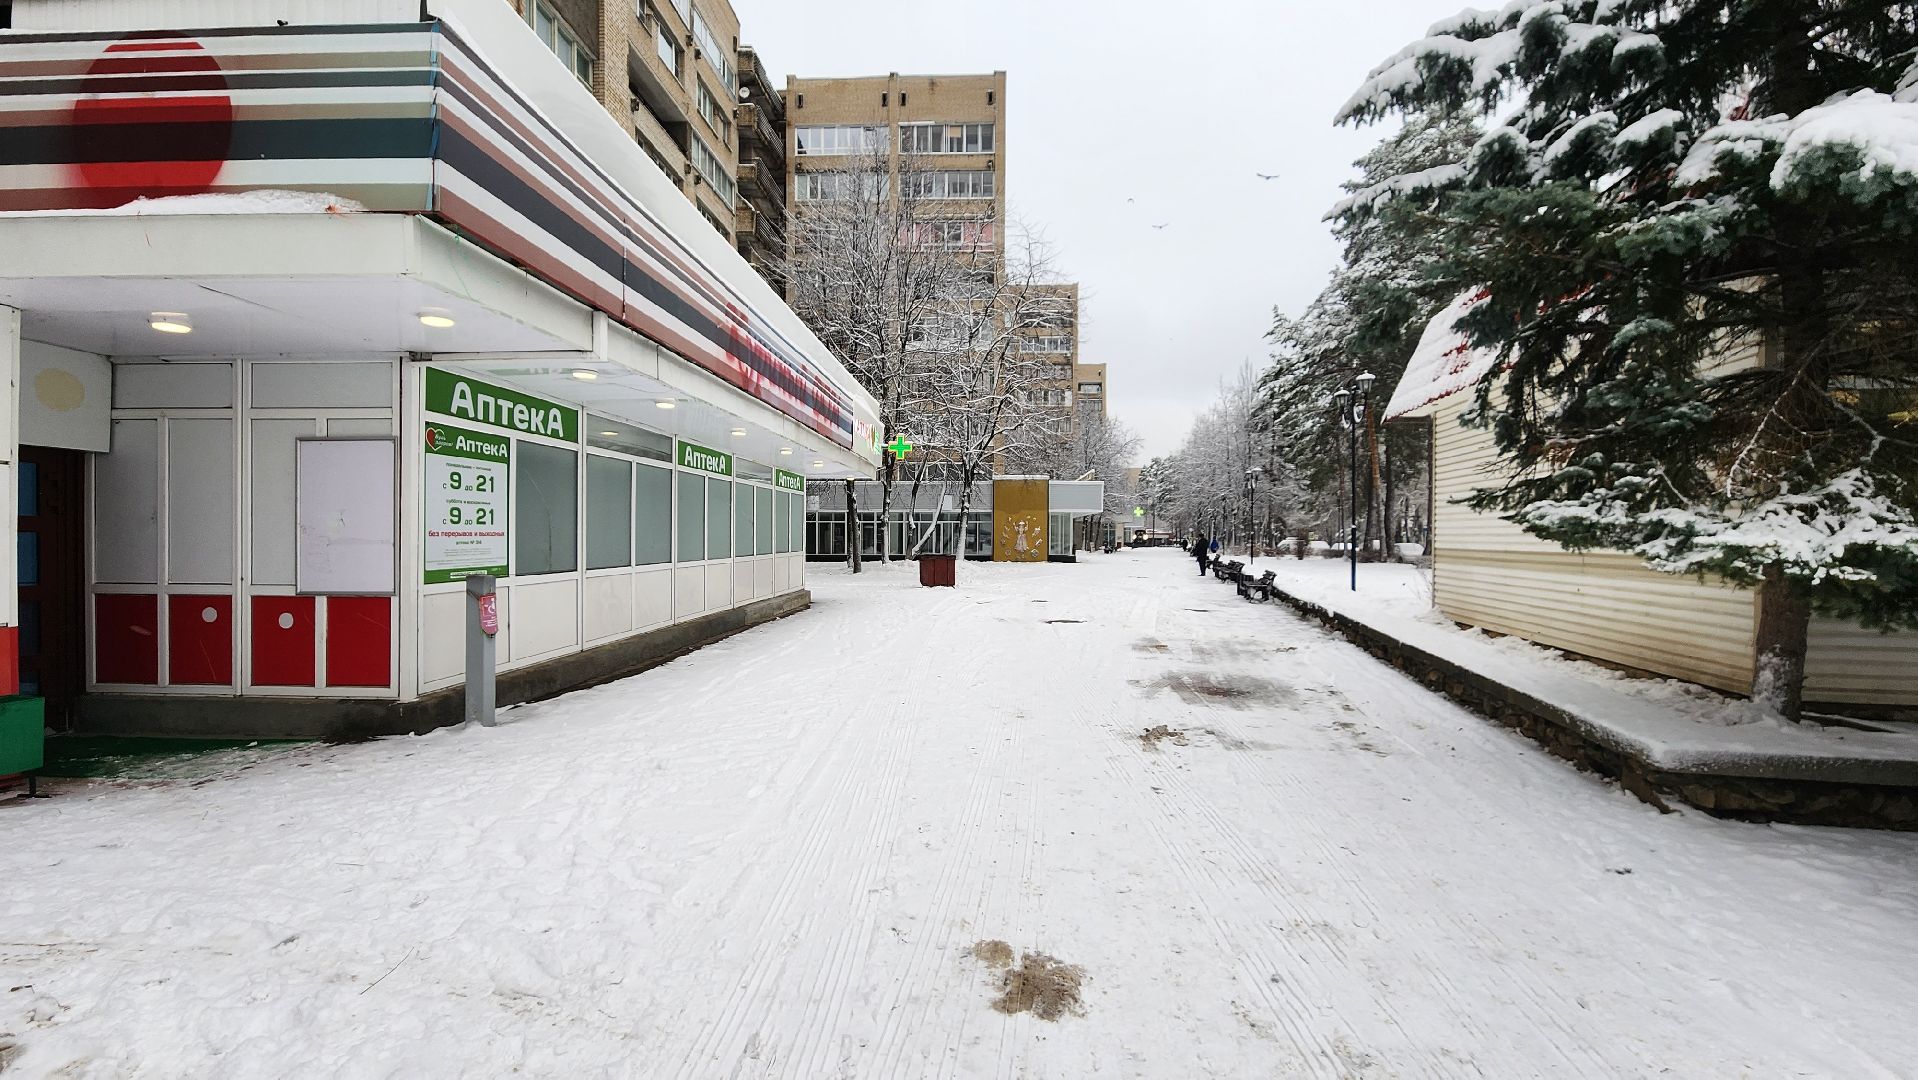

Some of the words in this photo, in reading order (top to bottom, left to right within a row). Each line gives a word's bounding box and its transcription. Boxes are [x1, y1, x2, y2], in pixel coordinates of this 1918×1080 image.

[450, 471, 462, 490] 9
[476, 474, 494, 493] 21
[449, 506, 462, 525] 9
[476, 507, 494, 526] 21
